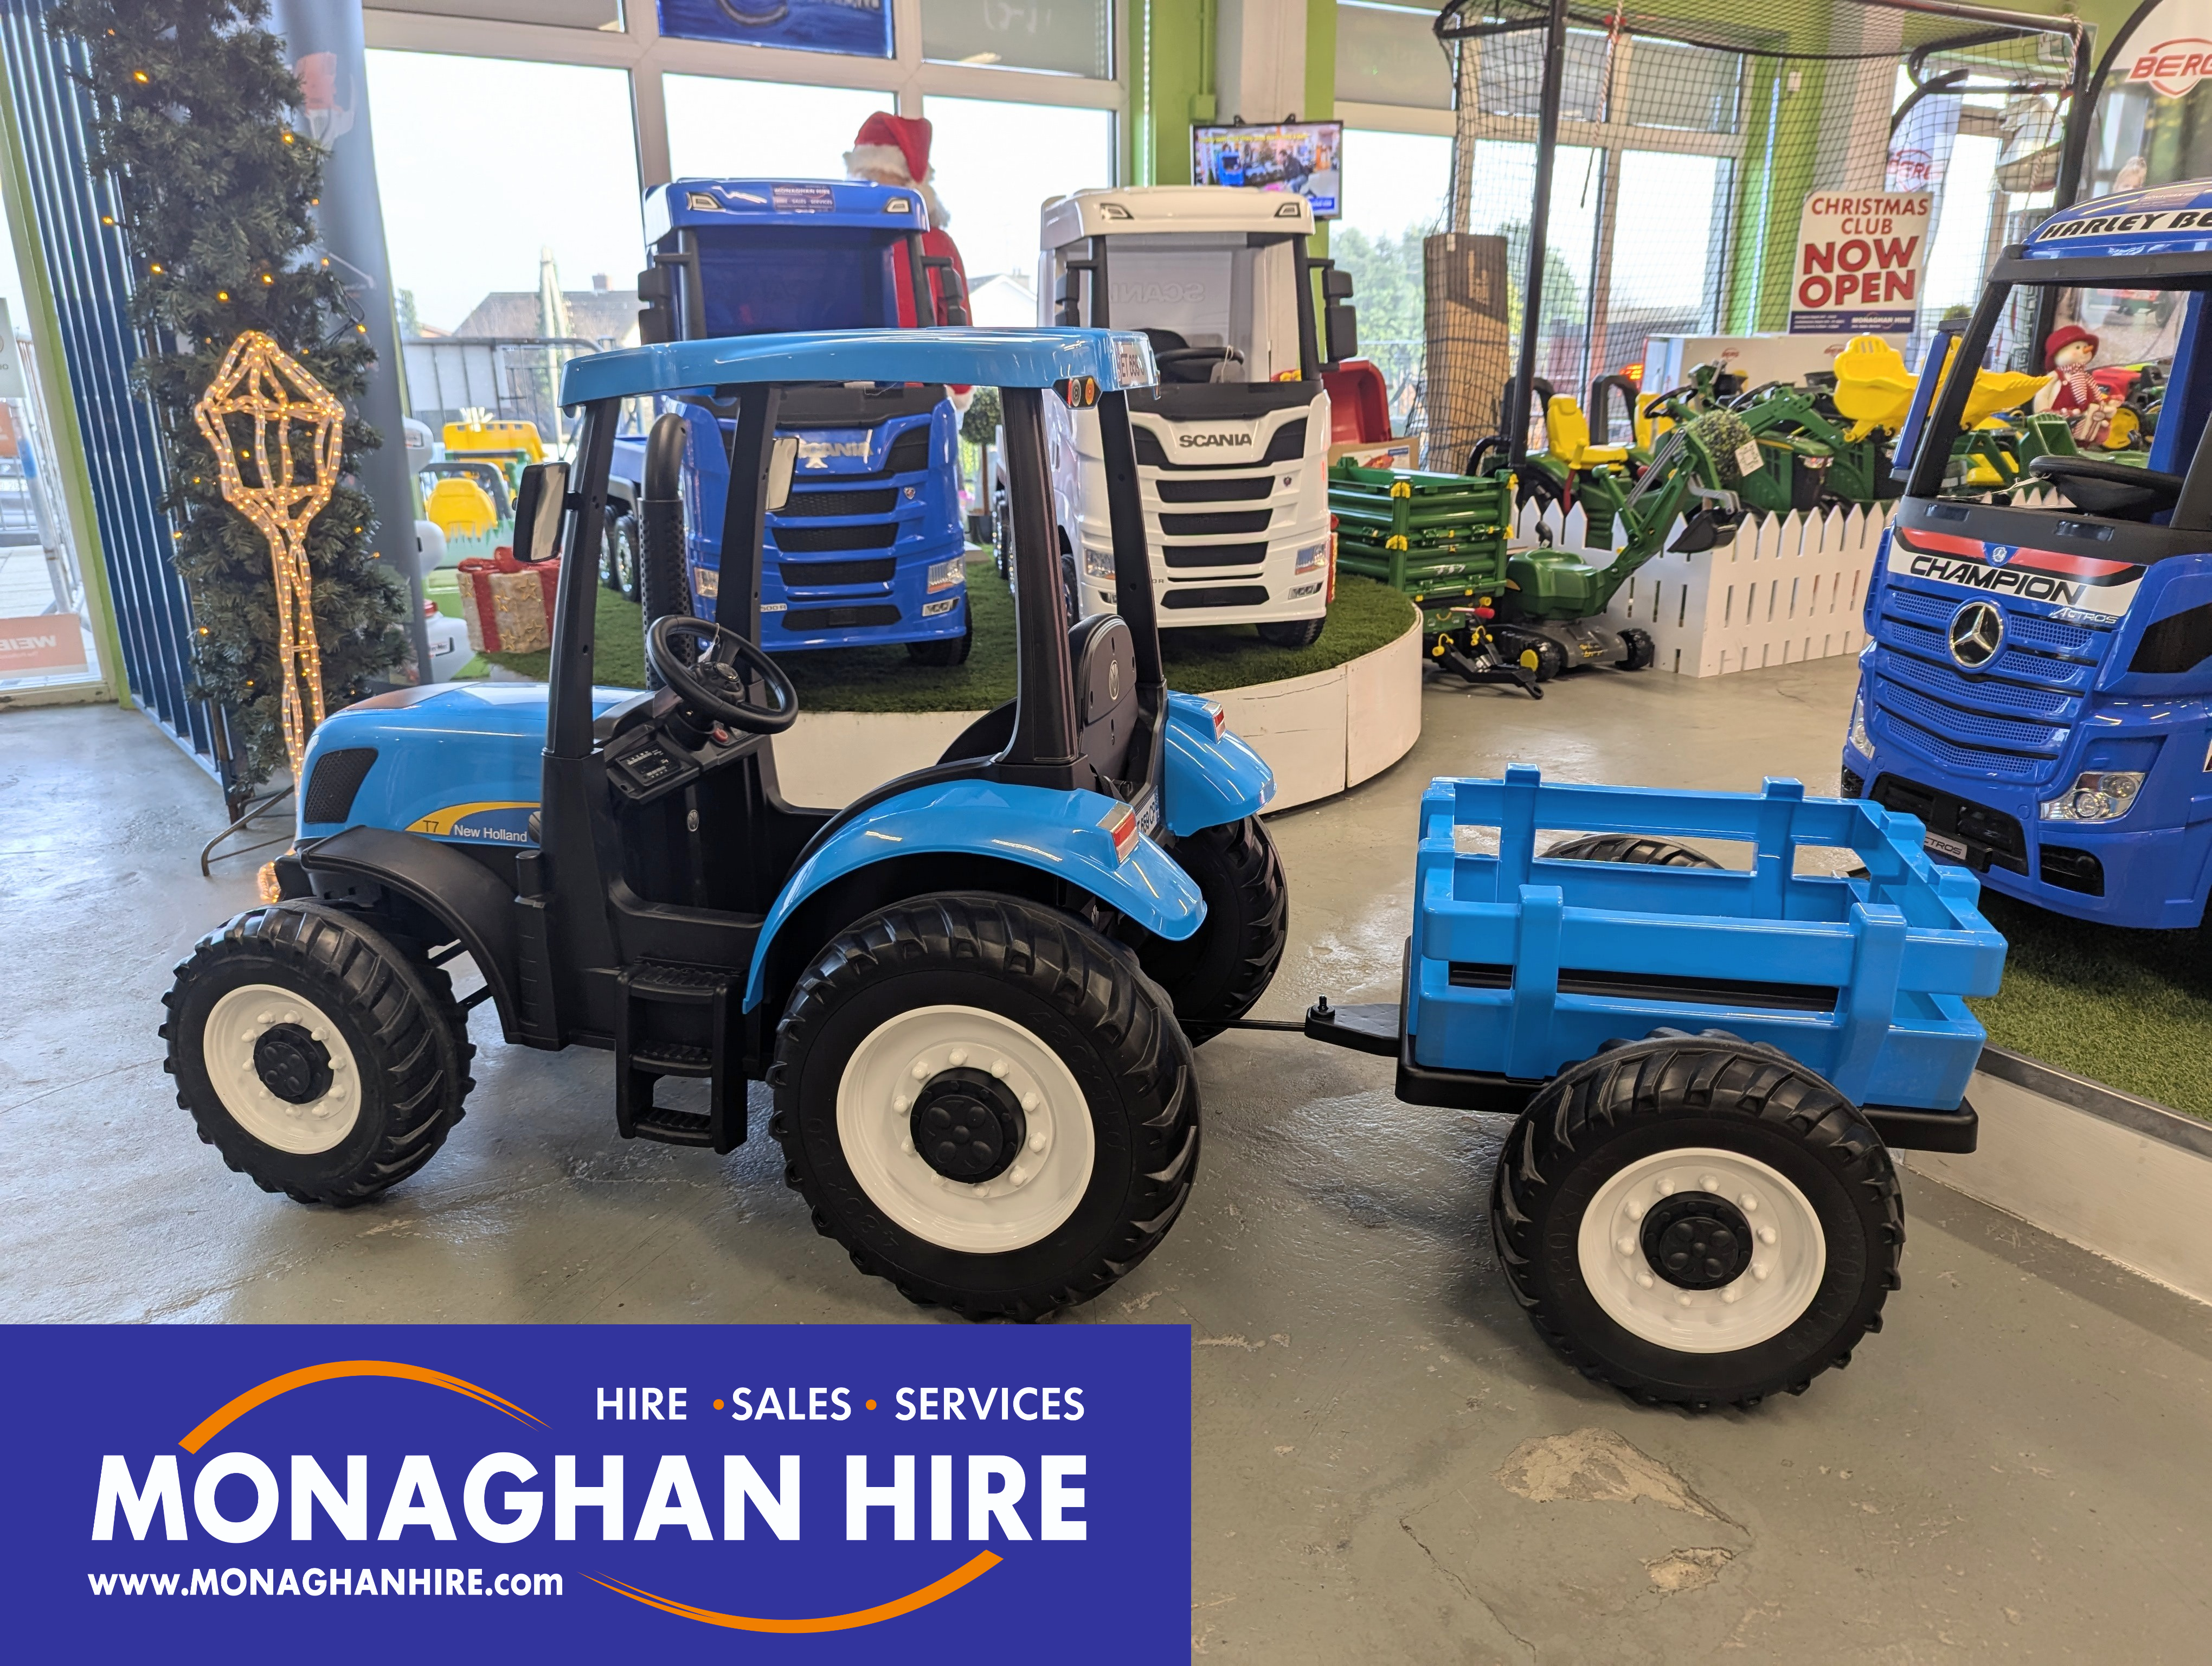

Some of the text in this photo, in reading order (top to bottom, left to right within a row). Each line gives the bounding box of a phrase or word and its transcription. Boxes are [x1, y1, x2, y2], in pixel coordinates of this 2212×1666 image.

[1811, 197, 1928, 216] CHRISTMAS
[1841, 217, 1893, 235] CLUB
[2039, 212, 2170, 240] HARLEY
[1803, 235, 1919, 275] NOW
[1799, 269, 1916, 308] OPEN
[1179, 433, 1252, 448] SCANIA
[1910, 555, 2087, 605] CHAMPION
[423, 820, 439, 832] T7
[454, 824, 528, 842] New Holland
